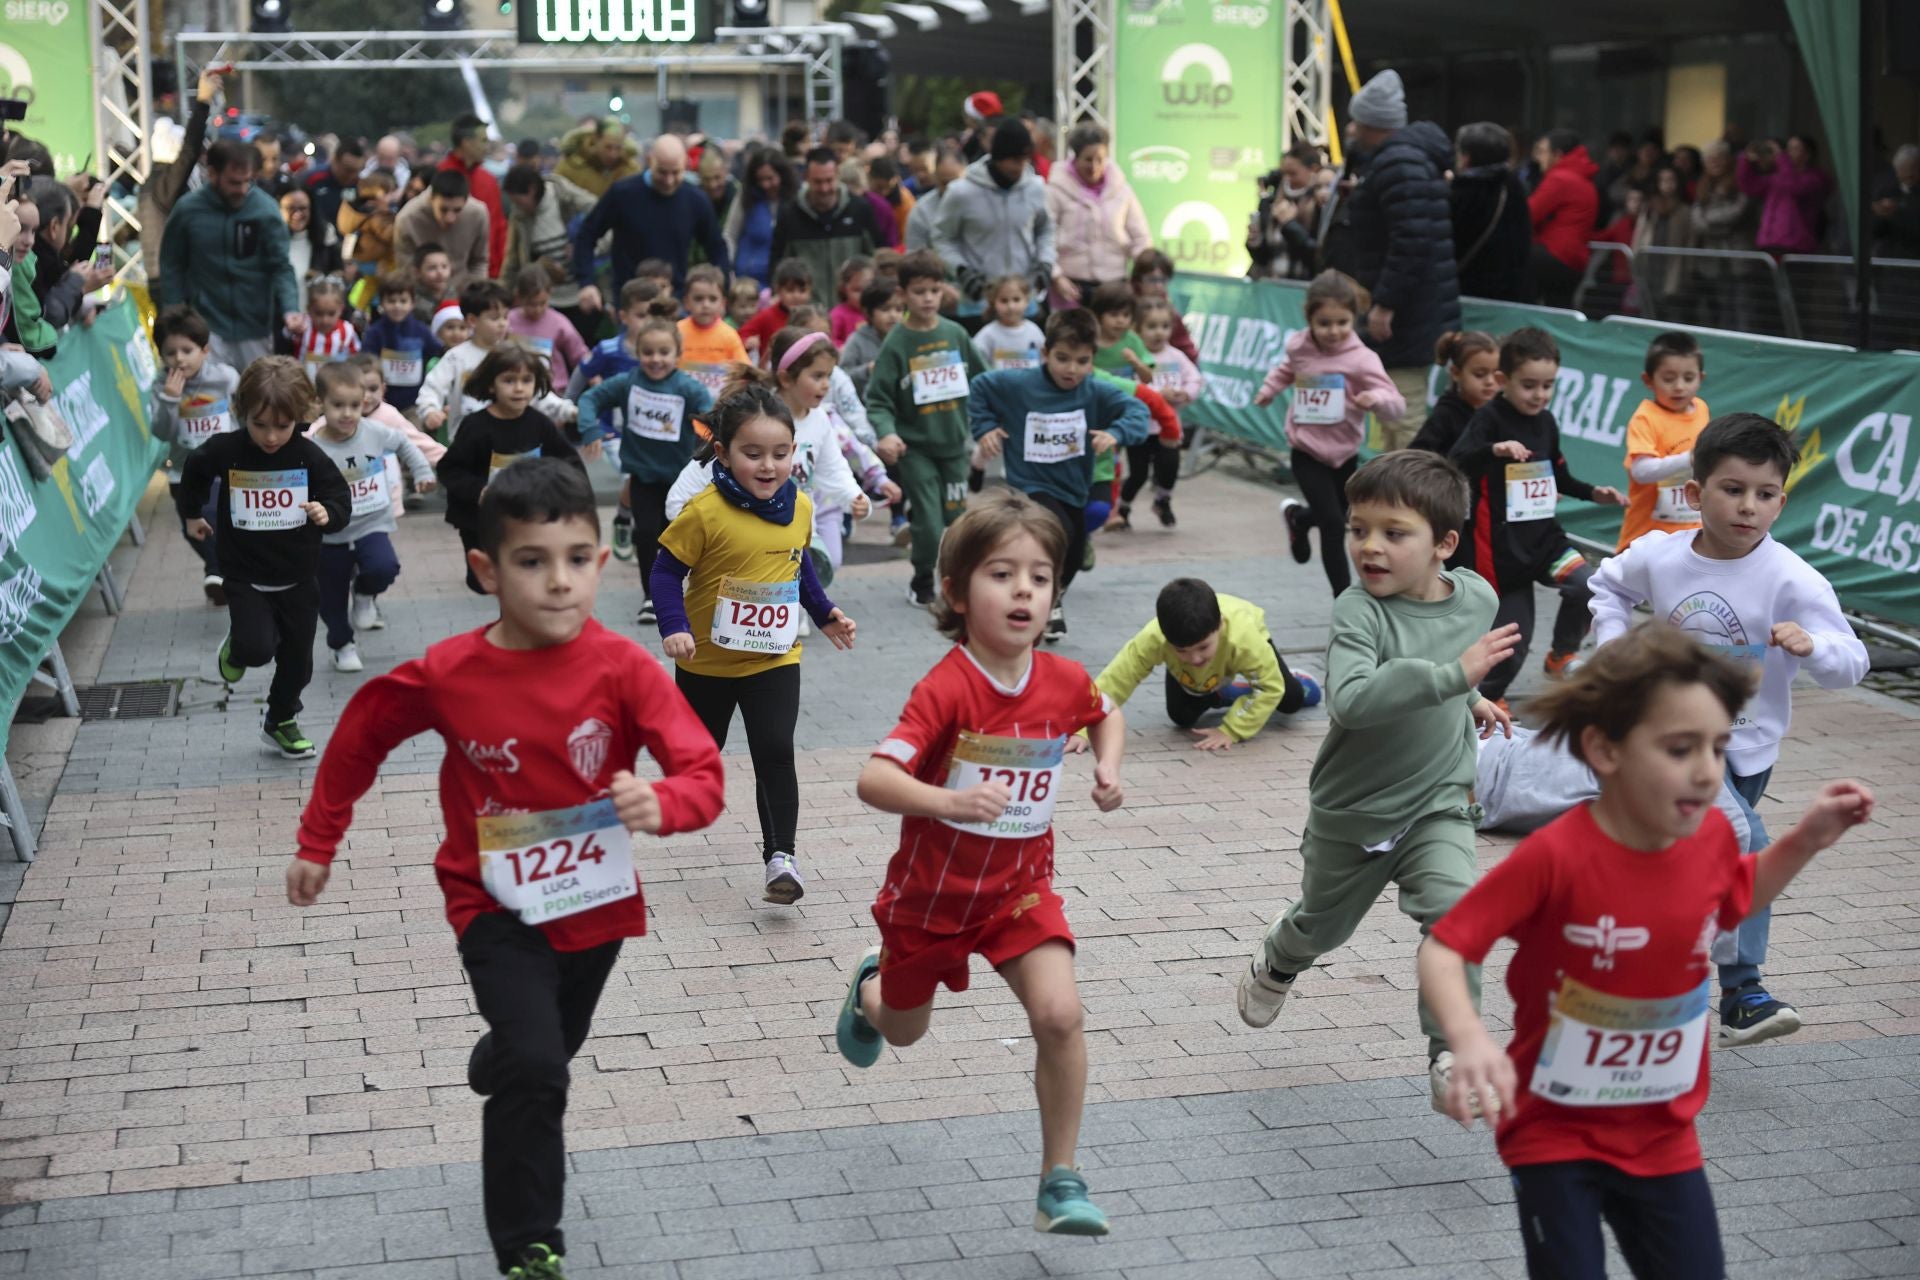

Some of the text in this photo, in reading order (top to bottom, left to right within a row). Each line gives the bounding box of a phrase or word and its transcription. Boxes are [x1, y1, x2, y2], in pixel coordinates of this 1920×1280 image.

[922, 365, 958, 385] 1276
[1298, 390, 1330, 406] 1147
[1547, 366, 1631, 447] RAL
[185, 415, 221, 433] 1182
[242, 489, 293, 509] 1180
[255, 510, 282, 518] DAVID
[1810, 502, 1868, 557] DE
[731, 601, 789, 629] 1209
[745, 629, 772, 638] ALMA
[1002, 805, 1032, 816] RBO
[505, 832, 606, 887] 1224
[541, 876, 581, 896] LUCA
[543, 884, 622, 914] PDMSiero
[1584, 1028, 1683, 1068] 1219
[1610, 1070, 1644, 1082] TEO
